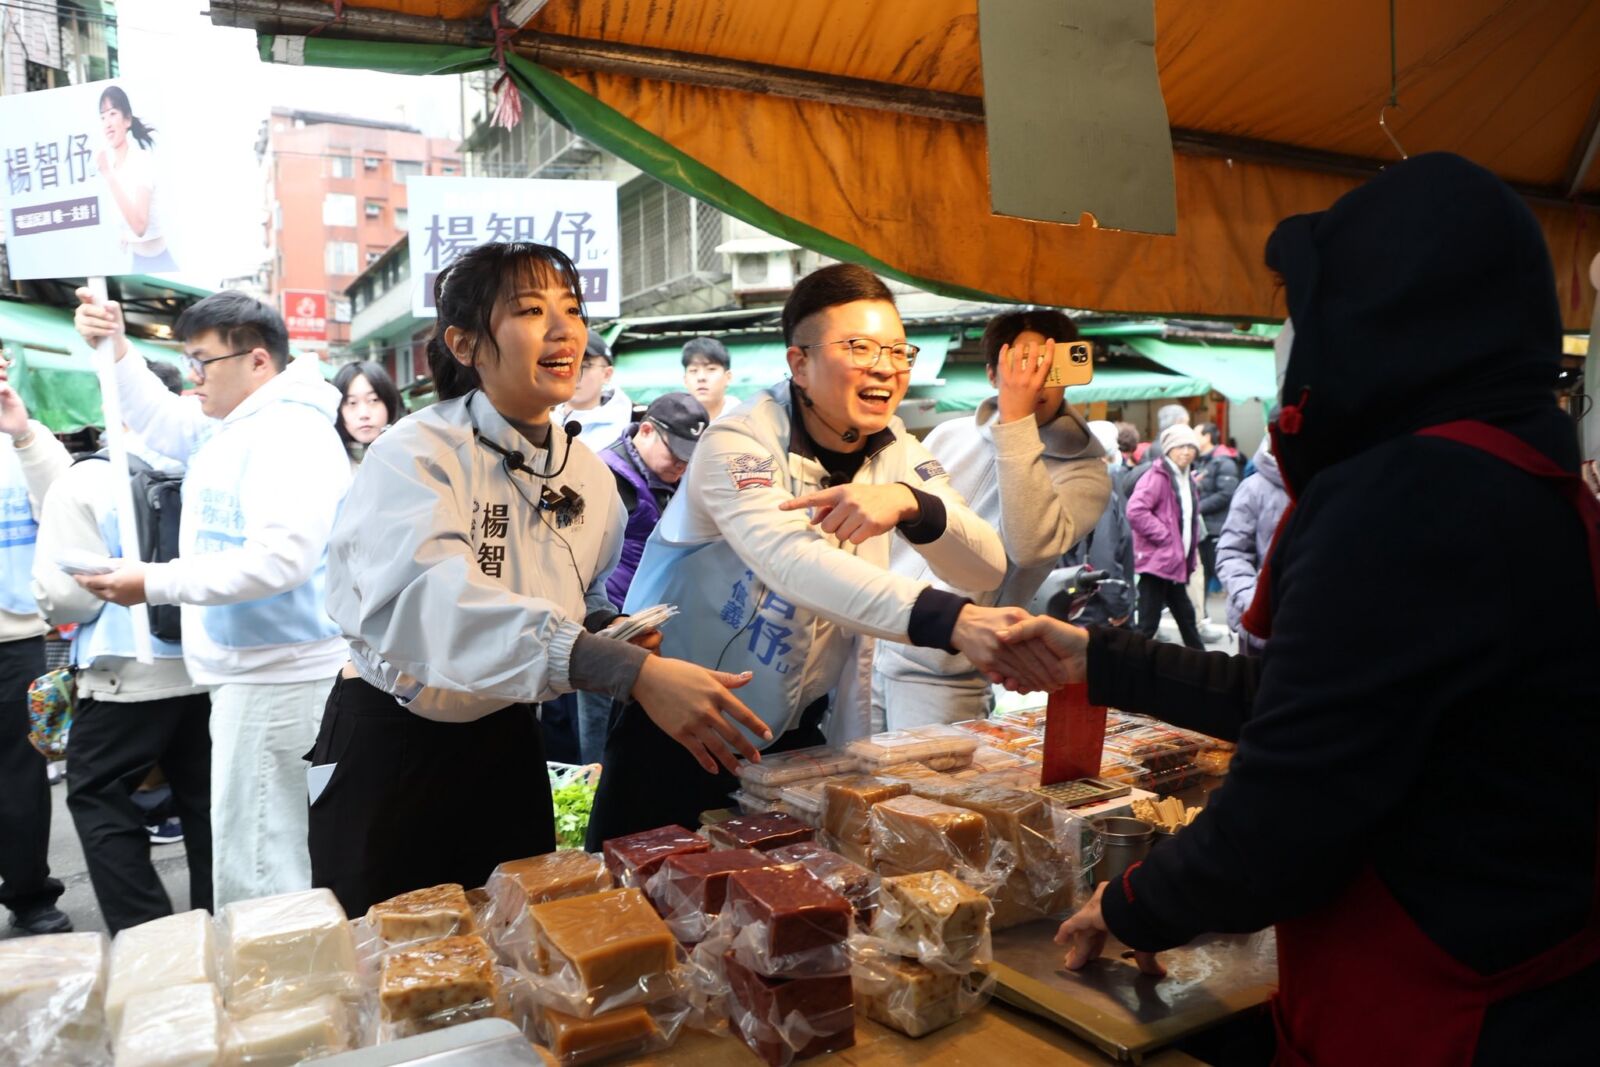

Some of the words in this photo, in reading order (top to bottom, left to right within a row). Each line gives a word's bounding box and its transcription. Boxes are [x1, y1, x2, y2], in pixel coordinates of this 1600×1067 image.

[4, 133, 92, 196] 楊智伃
[689, 421, 705, 436] J
[476, 502, 510, 579] 楊智
[720, 568, 755, 630] 信義
